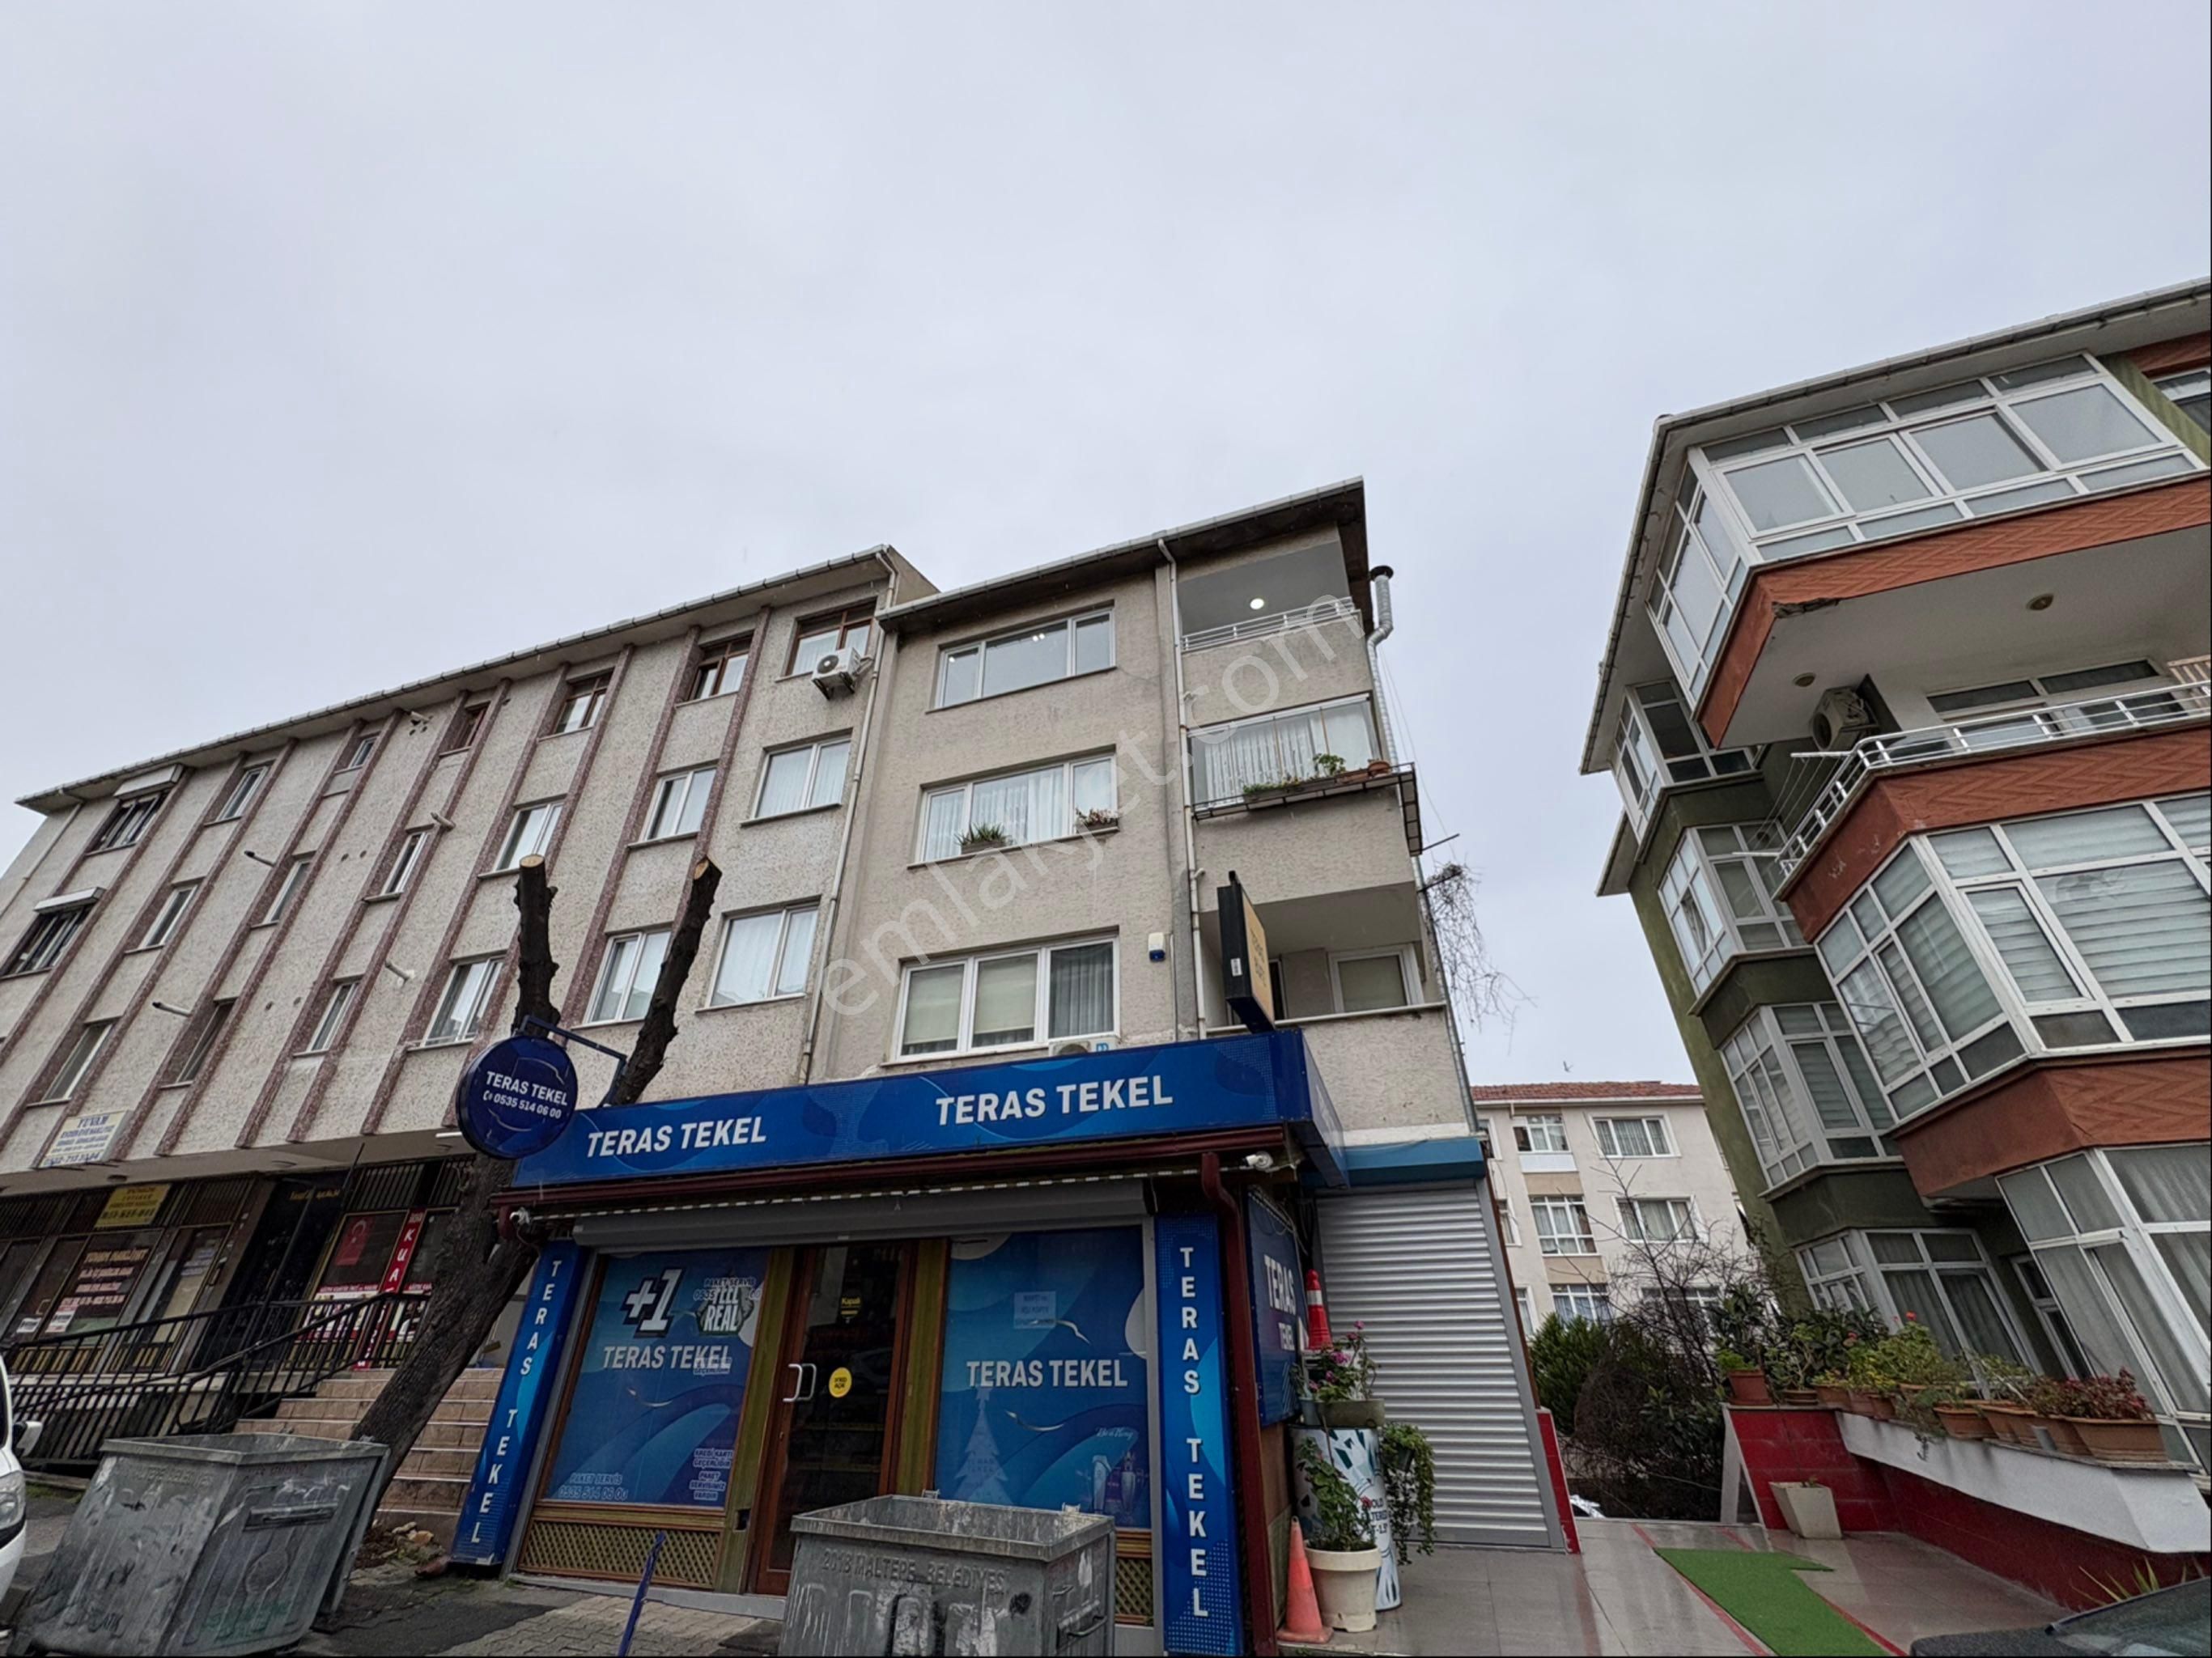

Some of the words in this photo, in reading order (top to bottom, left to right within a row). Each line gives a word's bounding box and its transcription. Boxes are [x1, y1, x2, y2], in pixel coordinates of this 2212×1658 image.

[486, 1071, 529, 1095] TERAS
[531, 1083, 567, 1106] TEKEL
[494, 1093, 518, 1108] 0535
[519, 1100, 536, 1112] 514
[537, 1105, 549, 1116] 06
[550, 1109, 562, 1119] 00
[936, 1088, 1045, 1126] TERAS
[1055, 1075, 1174, 1114] TEKEL
[587, 1125, 672, 1158] TERAS
[680, 1116, 766, 1150] TEKEL
[1264, 1254, 1296, 1316] TERAS
[520, 1260, 562, 1376] TERAS
[703, 1305, 738, 1331] REAL
[1179, 1246, 1199, 1395] TERAS
[603, 1346, 665, 1369] TERAS
[670, 1346, 731, 1369] TEKEL
[966, 1359, 1042, 1388] TERAS
[1049, 1359, 1128, 1388] TEKEL
[471, 1409, 518, 1543] TEKEL
[1187, 1438, 1208, 1617] TEKEL
[855, 1553, 916, 1581] MALTEPE
